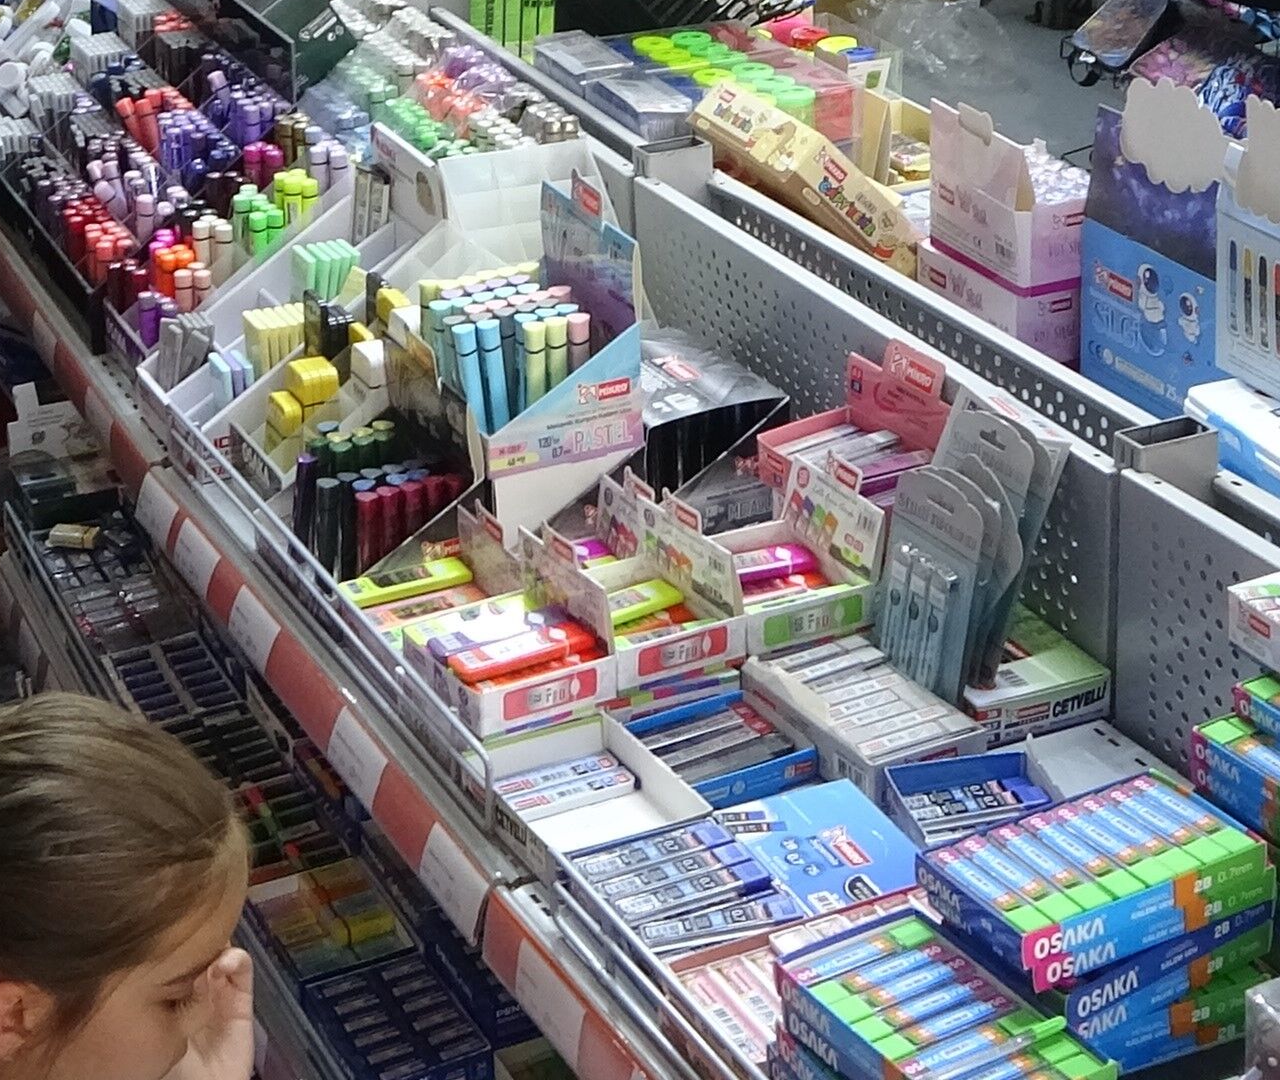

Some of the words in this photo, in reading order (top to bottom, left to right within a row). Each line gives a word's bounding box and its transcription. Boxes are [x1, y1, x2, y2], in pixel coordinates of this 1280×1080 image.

[573, 419, 634, 454] PASTEL
[1194, 874, 1213, 894] 2B
[1204, 899, 1222, 918] 2B
[1033, 917, 1105, 960] OSAKA
[1214, 920, 1231, 939] 2B
[1046, 940, 1116, 984] OSAKA
[1077, 970, 1139, 1017] OSAKA
[1077, 1003, 1128, 1041] SAKA
[1191, 1006, 1210, 1023] 2B
[788, 1011, 838, 1070] OSAKA
